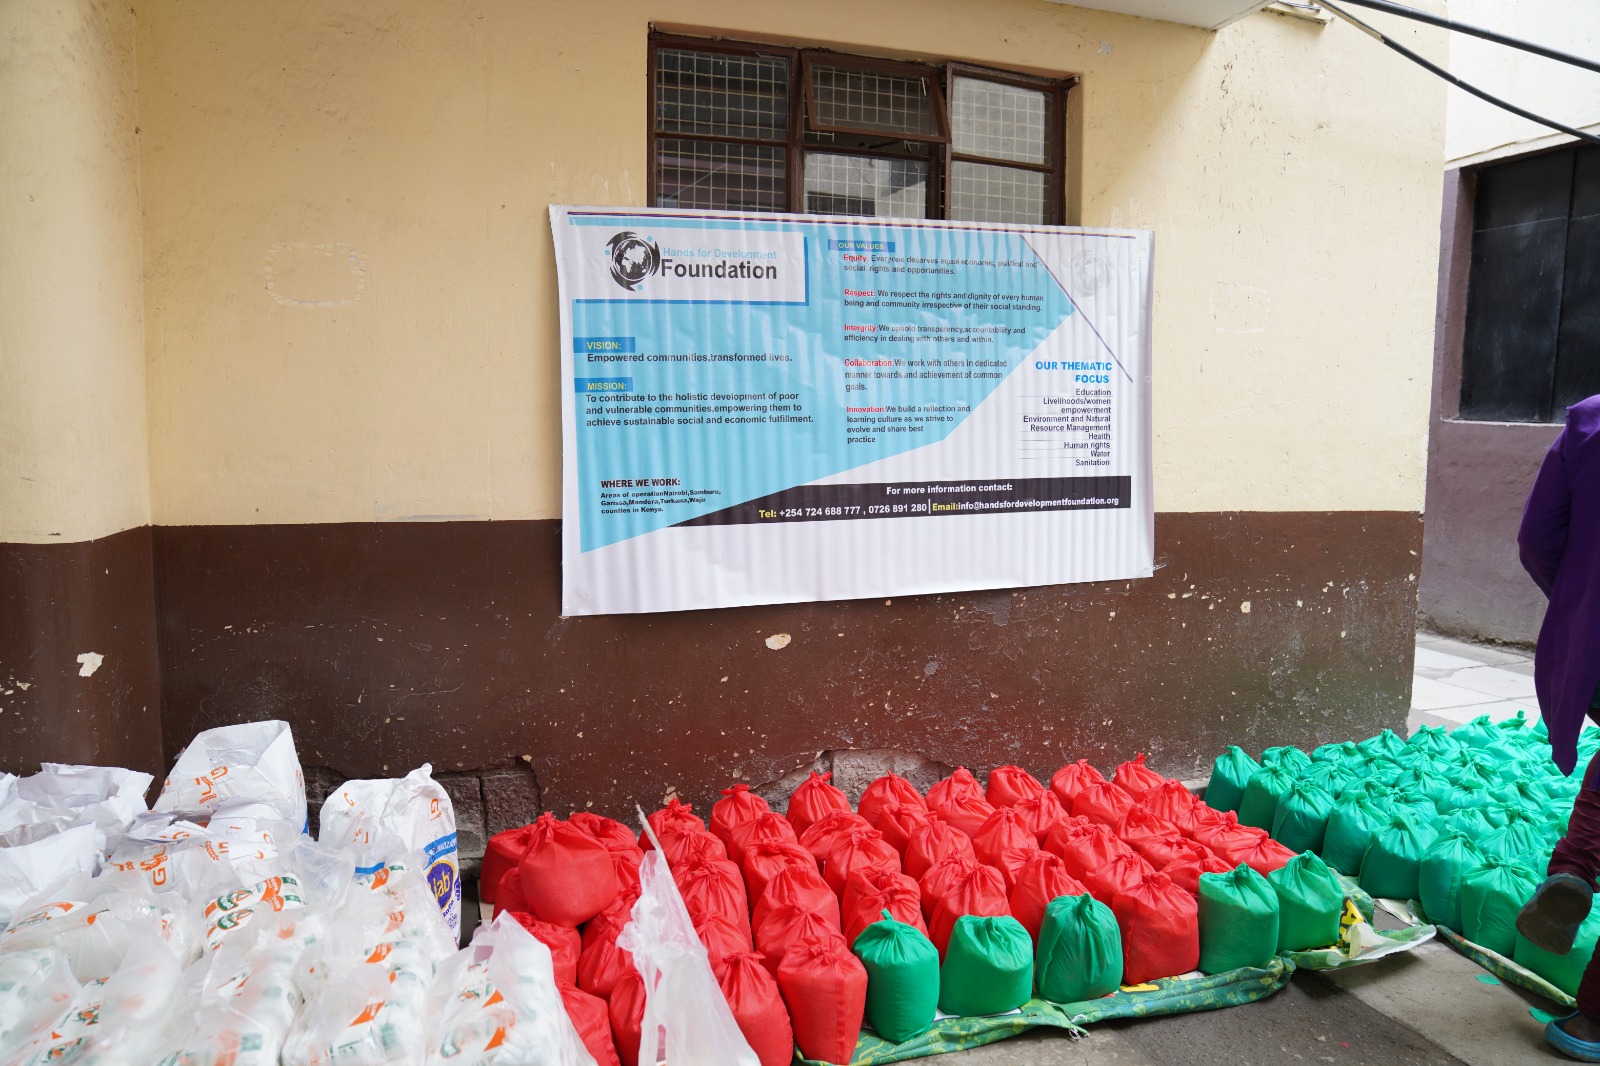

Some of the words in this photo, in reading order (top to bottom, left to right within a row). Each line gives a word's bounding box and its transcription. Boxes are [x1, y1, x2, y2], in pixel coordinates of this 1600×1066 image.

[663, 248, 694, 257] Hands
[697, 248, 711, 257] for
[715, 249, 776, 259] Development
[844, 254, 868, 262] Equity:
[872, 255, 904, 263] Everyone
[662, 259, 777, 279] Foundation
[907, 267, 955, 275] opportunities.
[845, 289, 875, 297] Respect:
[891, 291, 917, 299] respect
[932, 292, 951, 300] rights
[968, 293, 991, 301] dignity
[845, 299, 864, 307] being
[882, 301, 920, 309] community
[922, 301, 962, 309] irrespective
[1013, 303, 1042, 312] standing.
[844, 335, 878, 343] efficiency
[889, 335, 914, 344] dealing
[587, 342, 622, 350] VISION:
[588, 353, 644, 363] Empowered
[769, 353, 792, 362] lives.
[927, 359, 941, 367] with
[1036, 362, 1058, 370] OUR
[1061, 362, 1112, 371] THEMATIC
[874, 371, 902, 379] towards
[904, 371, 917, 379] and
[919, 371, 963, 379] achievement
[1075, 375, 1109, 383] FOCUS
[588, 382, 627, 390] MISSION:
[846, 383, 867, 392] goals.
[586, 394, 596, 402] To
[599, 393, 645, 402] contribute
[659, 393, 672, 401] the
[676, 392, 708, 401] holistic
[711, 392, 765, 402] development
[768, 392, 776, 400] of
[779, 393, 799, 401] poor
[586, 405, 603, 414] and
[606, 405, 652, 414] vulnerable
[769, 403, 790, 411] them
[587, 417, 621, 426] achieve
[624, 417, 674, 425] sustainable
[677, 416, 703, 425] social
[706, 416, 722, 424] and
[725, 415, 766, 424] economic
[769, 414, 813, 423] fulfillment.
[847, 415, 876, 424] learning
[878, 415, 901, 423] culture
[847, 425, 870, 433] evolve
[1067, 424, 1111, 432] Management
[848, 435, 876, 443] practice
[1091, 442, 1110, 450] rights
[601, 480, 633, 488] WHERE
[636, 479, 649, 487] WE
[652, 478, 680, 486] WORK:
[887, 487, 900, 495] For
[928, 484, 976, 493] information
[979, 483, 1012, 491] contact:
[759, 510, 776, 518] Tel:
[780, 508, 802, 517] +254
[806, 508, 822, 516] 724
[825, 507, 842, 515] 688
[844, 506, 860, 515] 777
[869, 504, 890, 513] 0726
[892, 504, 908, 512] 891
[911, 503, 927, 512] 280
